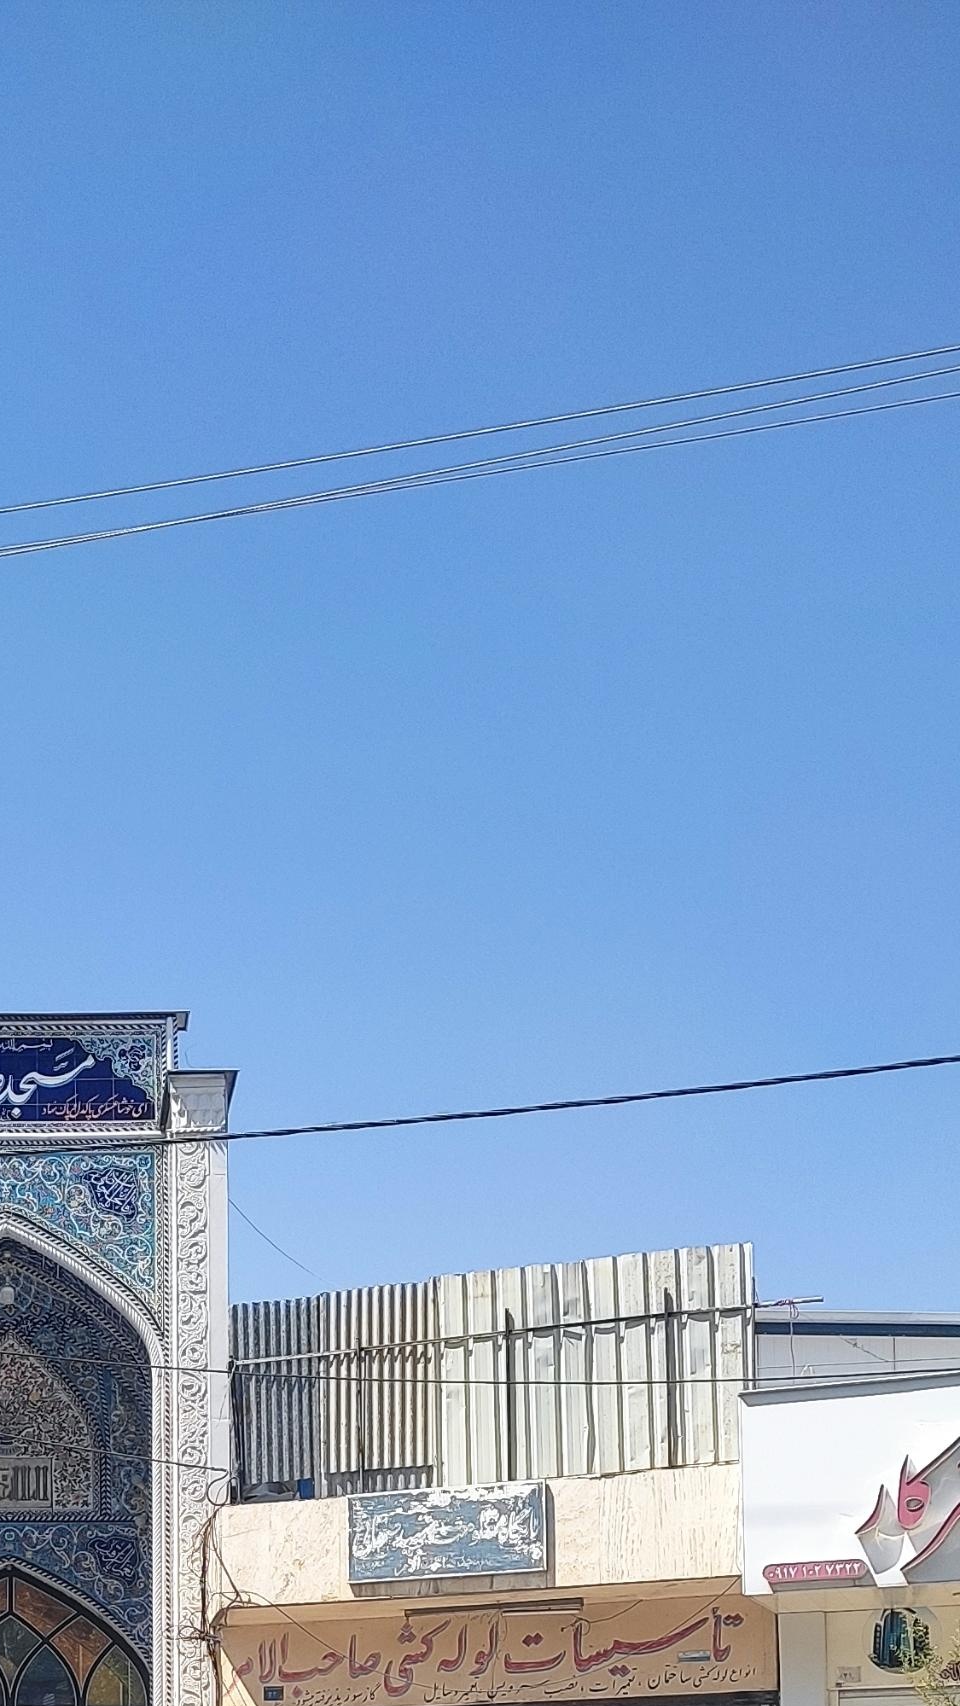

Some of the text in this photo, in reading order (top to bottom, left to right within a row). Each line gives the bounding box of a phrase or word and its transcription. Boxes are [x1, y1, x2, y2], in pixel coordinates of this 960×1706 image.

[769, 1565, 797, 1579] ۰۹۱۷
[802, 1564, 821, 1577] ۱۰۲
[383, 1618, 452, 1698] کشی
[436, 1619, 500, 1677] لوله
[503, 1606, 745, 1678] تأسیسات
[278, 1634, 382, 1699] صاحب
[712, 1668, 728, 1683] لوله
[730, 1665, 757, 1682] انواع
[543, 1678, 580, 1696] نصب
